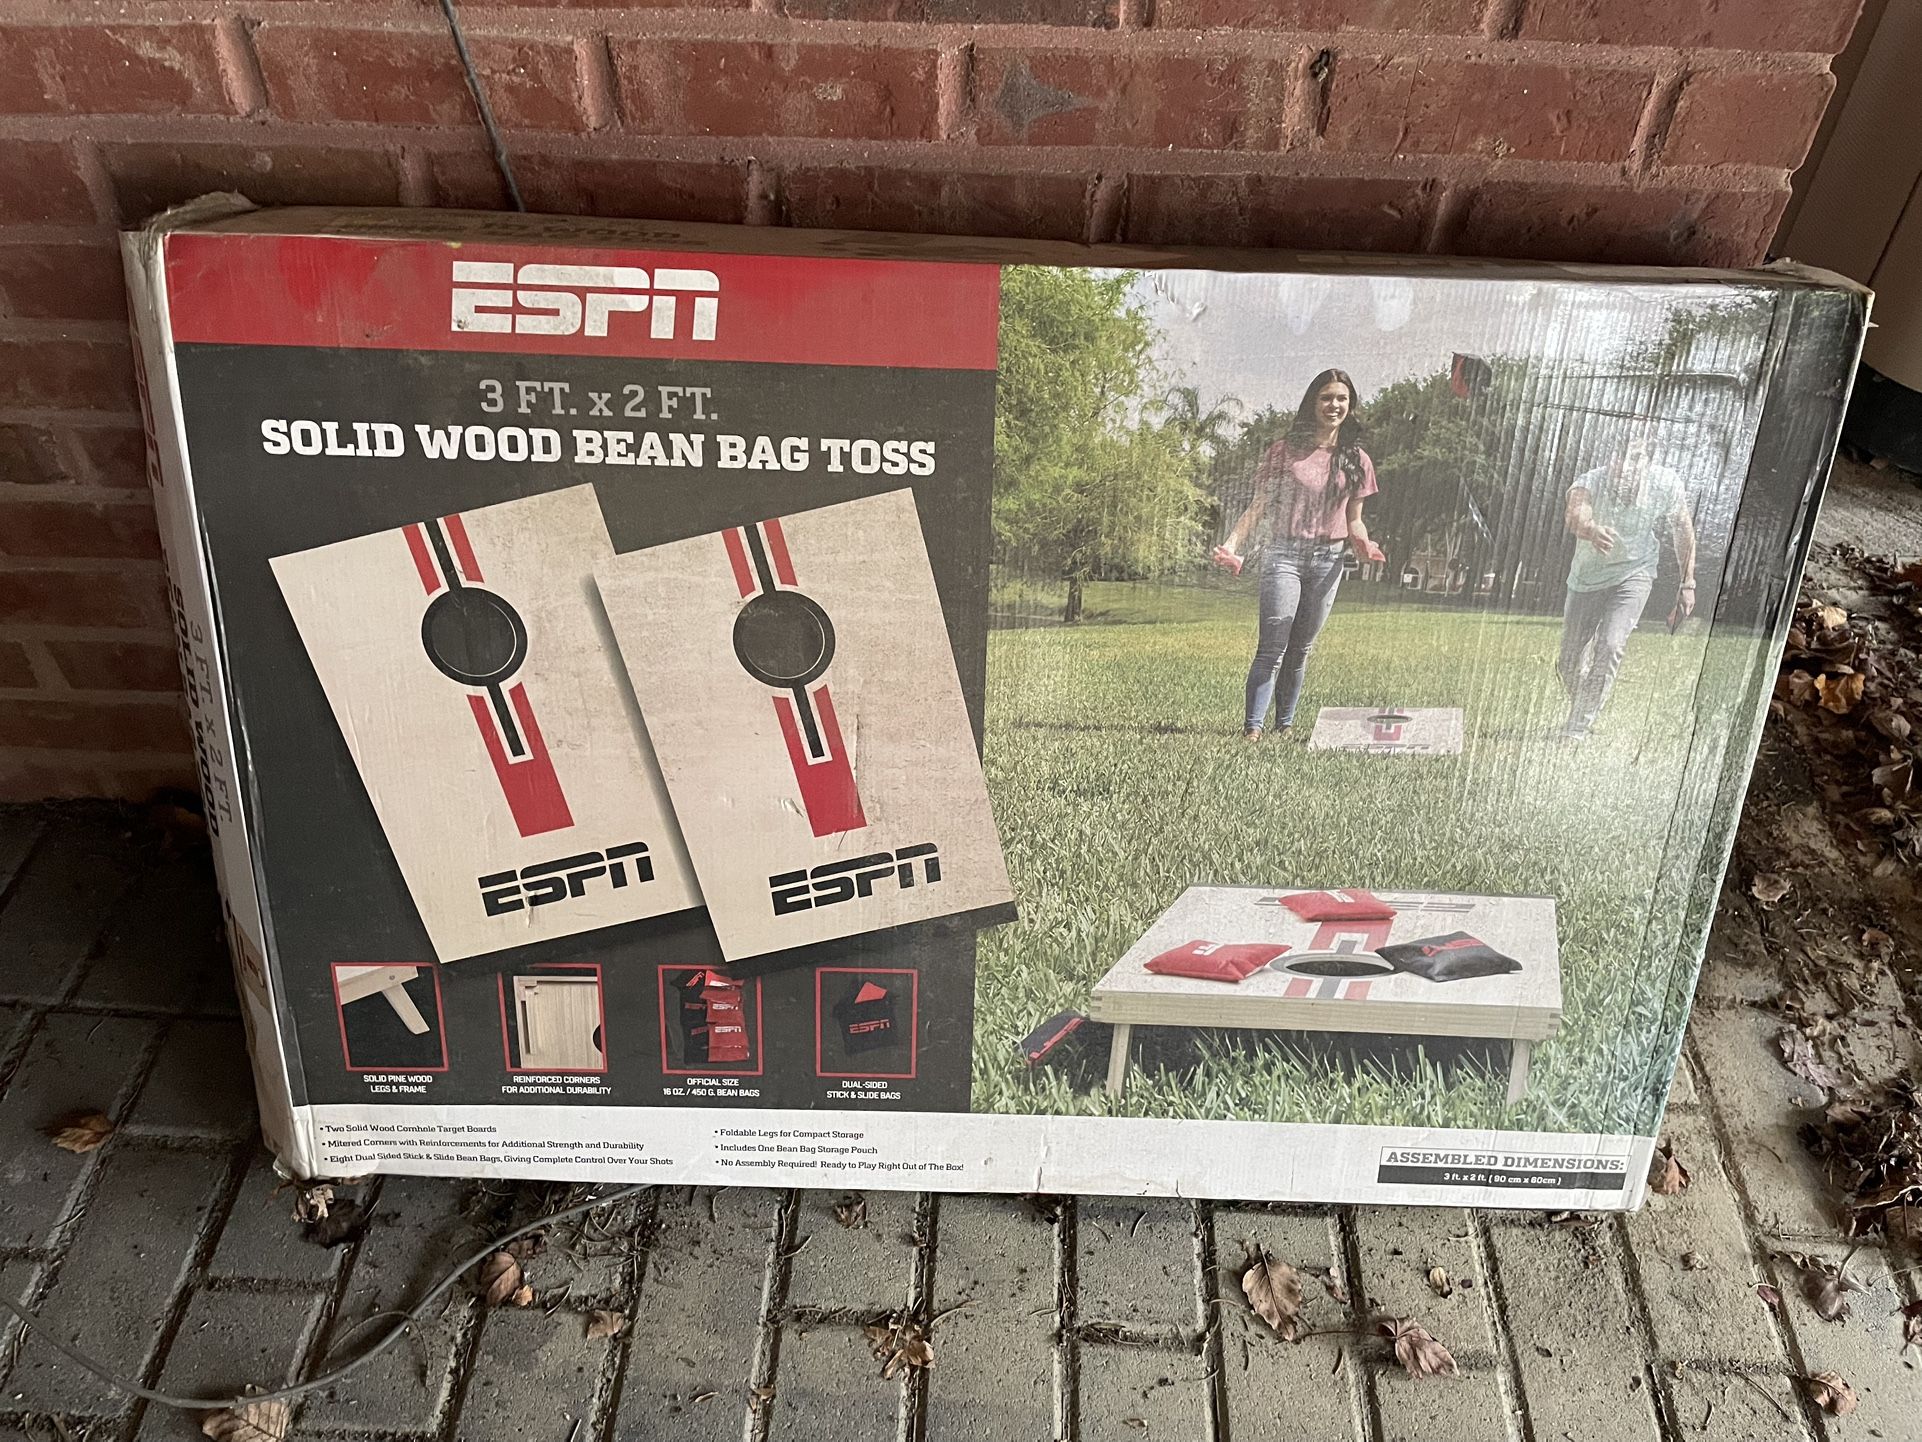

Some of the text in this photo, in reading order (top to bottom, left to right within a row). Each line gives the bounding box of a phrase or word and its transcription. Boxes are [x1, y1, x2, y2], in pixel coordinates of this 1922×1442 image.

[451, 260, 720, 341] ESPN
[479, 379, 718, 420] 3 FT. x 2 FT.
[260, 419, 936, 476] SOLID WOOD BEAN BAG TOSS
[189, 619, 203, 644] 3
[173, 583, 200, 709] SOLID
[194, 719, 220, 838] WOOD
[477, 841, 655, 918] ESPN
[768, 842, 942, 917] ESPN
[714, 1025, 742, 1033] ESPN
[849, 1019, 890, 1034] ESPN
[363, 1074, 433, 1084] SOLID PINE WOOD
[513, 1075, 601, 1084] REINFORCED CORNERS
[686, 1078, 739, 1087] OFFICIAL SIZE
[842, 1080, 888, 1089] DUAL-SIDED
[370, 1085, 427, 1093] LEGS & FRAME
[502, 1085, 612, 1095] FOR ADDITIONAL DURABILITY
[663, 1088, 672, 1096] 16
[691, 1088, 707, 1096] 450
[717, 1088, 738, 1097] BEAN
[739, 1089, 760, 1097] BAGS
[826, 1090, 901, 1100] STICK & SLIDE BAGS
[346, 1124, 368, 1132] Solid
[370, 1124, 395, 1132] Wood
[396, 1124, 436, 1132] Cornhole
[437, 1125, 465, 1134] Target
[467, 1125, 497, 1133] Boards
[720, 1128, 864, 1140] Foldable Legs for Compact Storage
[328, 1138, 644, 1151] Mitered Corners with Reinforcements for Additional Strength and Durability
[720, 1144, 757, 1152] Includes
[757, 1144, 775, 1152] One
[799, 1145, 816, 1154] Bag
[817, 1146, 849, 1155] Storage
[851, 1146, 878, 1154] Pouch
[330, 1155, 353, 1163] Eight
[355, 1153, 376, 1161] Dual
[433, 1153, 454, 1161] Slide
[479, 1155, 502, 1163] Bags,
[504, 1155, 531, 1164] Giving
[533, 1155, 573, 1164] Complete
[574, 1156, 606, 1164] Control
[628, 1157, 648, 1165] Your
[649, 1157, 673, 1165] Shots
[735, 1159, 776, 1168] Assembly
[777, 1160, 817, 1169] Required!
[820, 1161, 847, 1170] Ready
[858, 1162, 876, 1170] Play
[878, 1162, 900, 1171] Right
[902, 1162, 917, 1170] Out
[946, 1163, 964, 1171] Box!
[1386, 1151, 1625, 1170] ASSEMBLED DIMENSIONS:
[1443, 1172, 1450, 1181] 3
[1451, 1173, 1461, 1181] ft.
[1470, 1173, 1476, 1182] 2
[1477, 1173, 1487, 1182] ft.
[1494, 1174, 1506, 1183] 90
[1522, 1176, 1530, 1184] x
